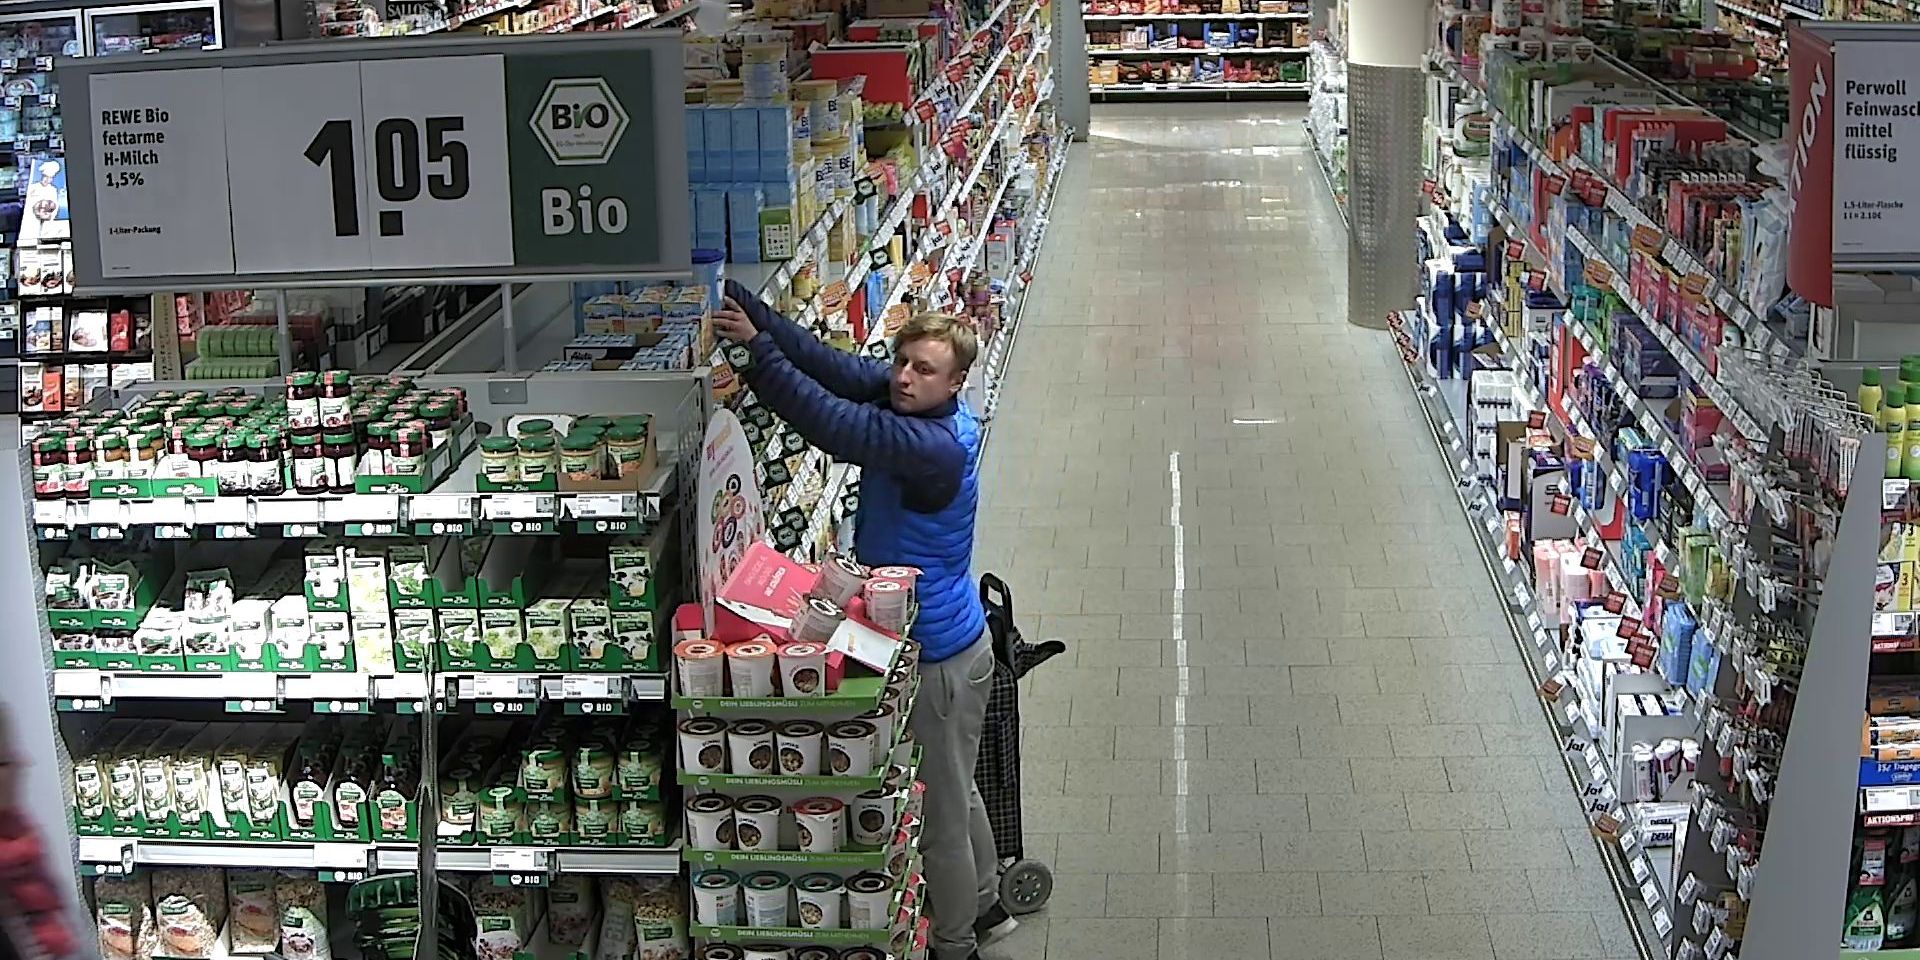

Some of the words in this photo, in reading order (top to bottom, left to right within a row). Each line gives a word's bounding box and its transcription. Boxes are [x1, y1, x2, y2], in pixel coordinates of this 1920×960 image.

[1846, 79, 1906, 96] Perwoll
[102, 109, 142, 126] REWE
[145, 108, 169, 124] Bio
[103, 130, 165, 146] fettarme
[1846, 122, 1892, 138] mittel
[104, 149, 159, 166] H-Milch
[1845, 143, 1897, 162] flüssig
[106, 172, 144, 189] 1,5%
[541, 184, 628, 235] Bio
[446, 524, 463, 533] BIO
[525, 522, 541, 532] BIO
[610, 522, 627, 531] BIO
[507, 703, 523, 712] BIO
[596, 703, 612, 712] BIO
